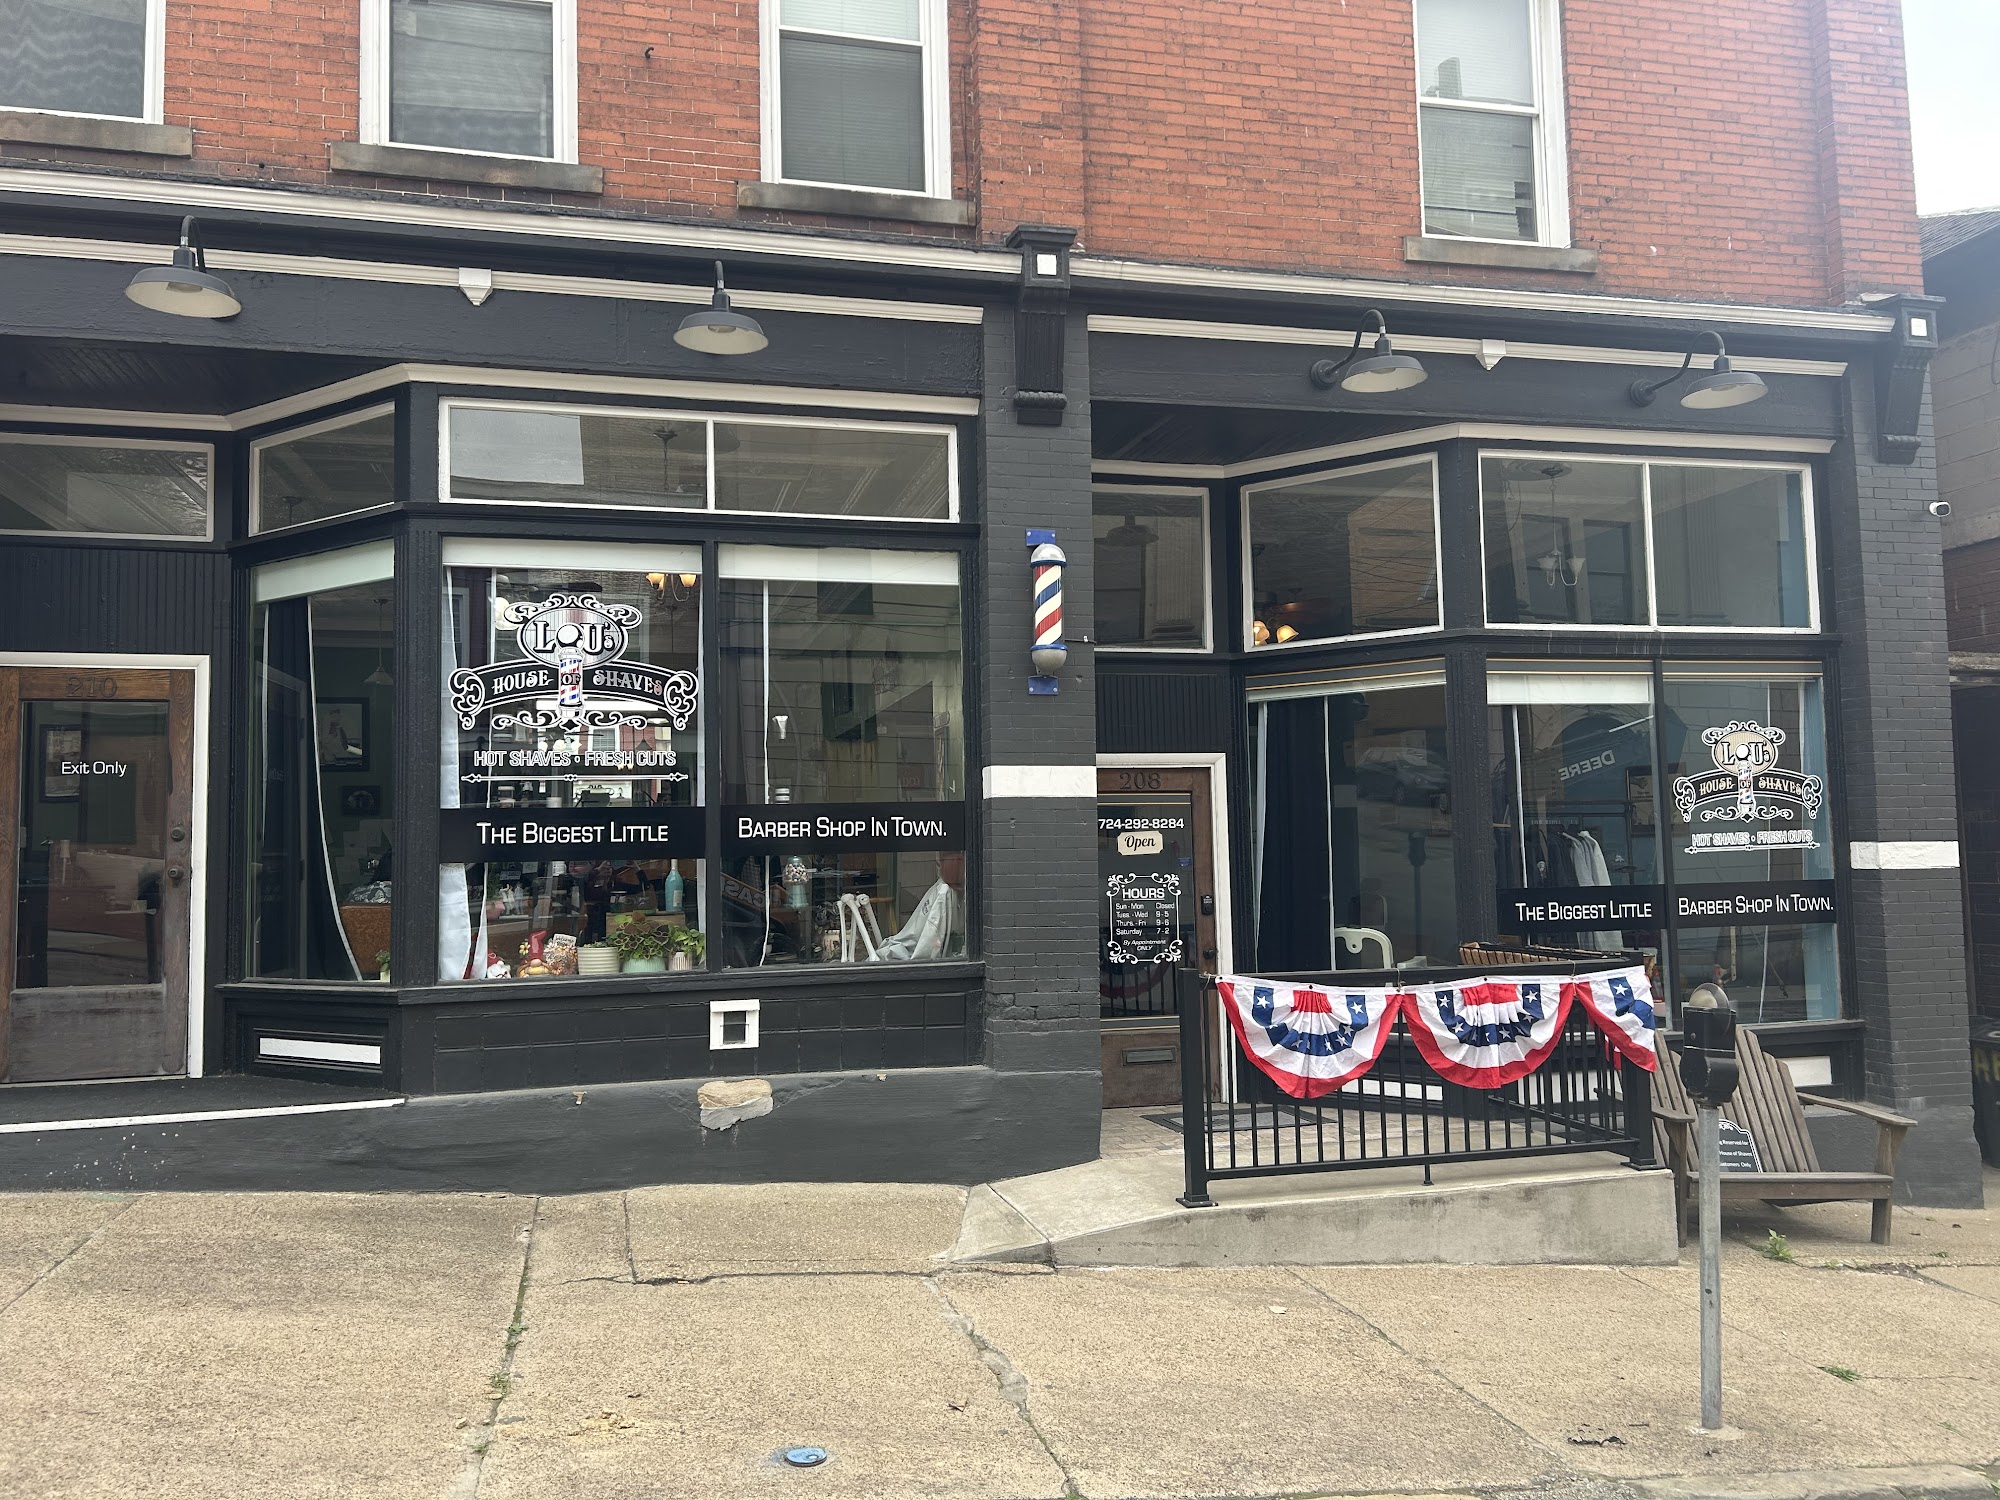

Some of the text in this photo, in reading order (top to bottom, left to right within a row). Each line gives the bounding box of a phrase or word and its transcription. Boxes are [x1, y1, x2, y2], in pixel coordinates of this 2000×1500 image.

[66, 676, 118, 699] 210
[491, 669, 663, 696] HOUSE OF SHAVES
[473, 750, 677, 767] HOT SHAVES FRESH CUTS
[61, 761, 127, 778] Exit Only
[1119, 772, 1161, 789] 208
[1699, 776, 1802, 796] HOUSE OF SHAVES
[1098, 818, 1185, 830] 724-292-8284
[1124, 834, 1157, 852] Open
[1691, 829, 1813, 847] HOT SHAVES FRESH CUTS
[1122, 888, 1165, 899] HOURS
[1115, 928, 1143, 936] Saturday
